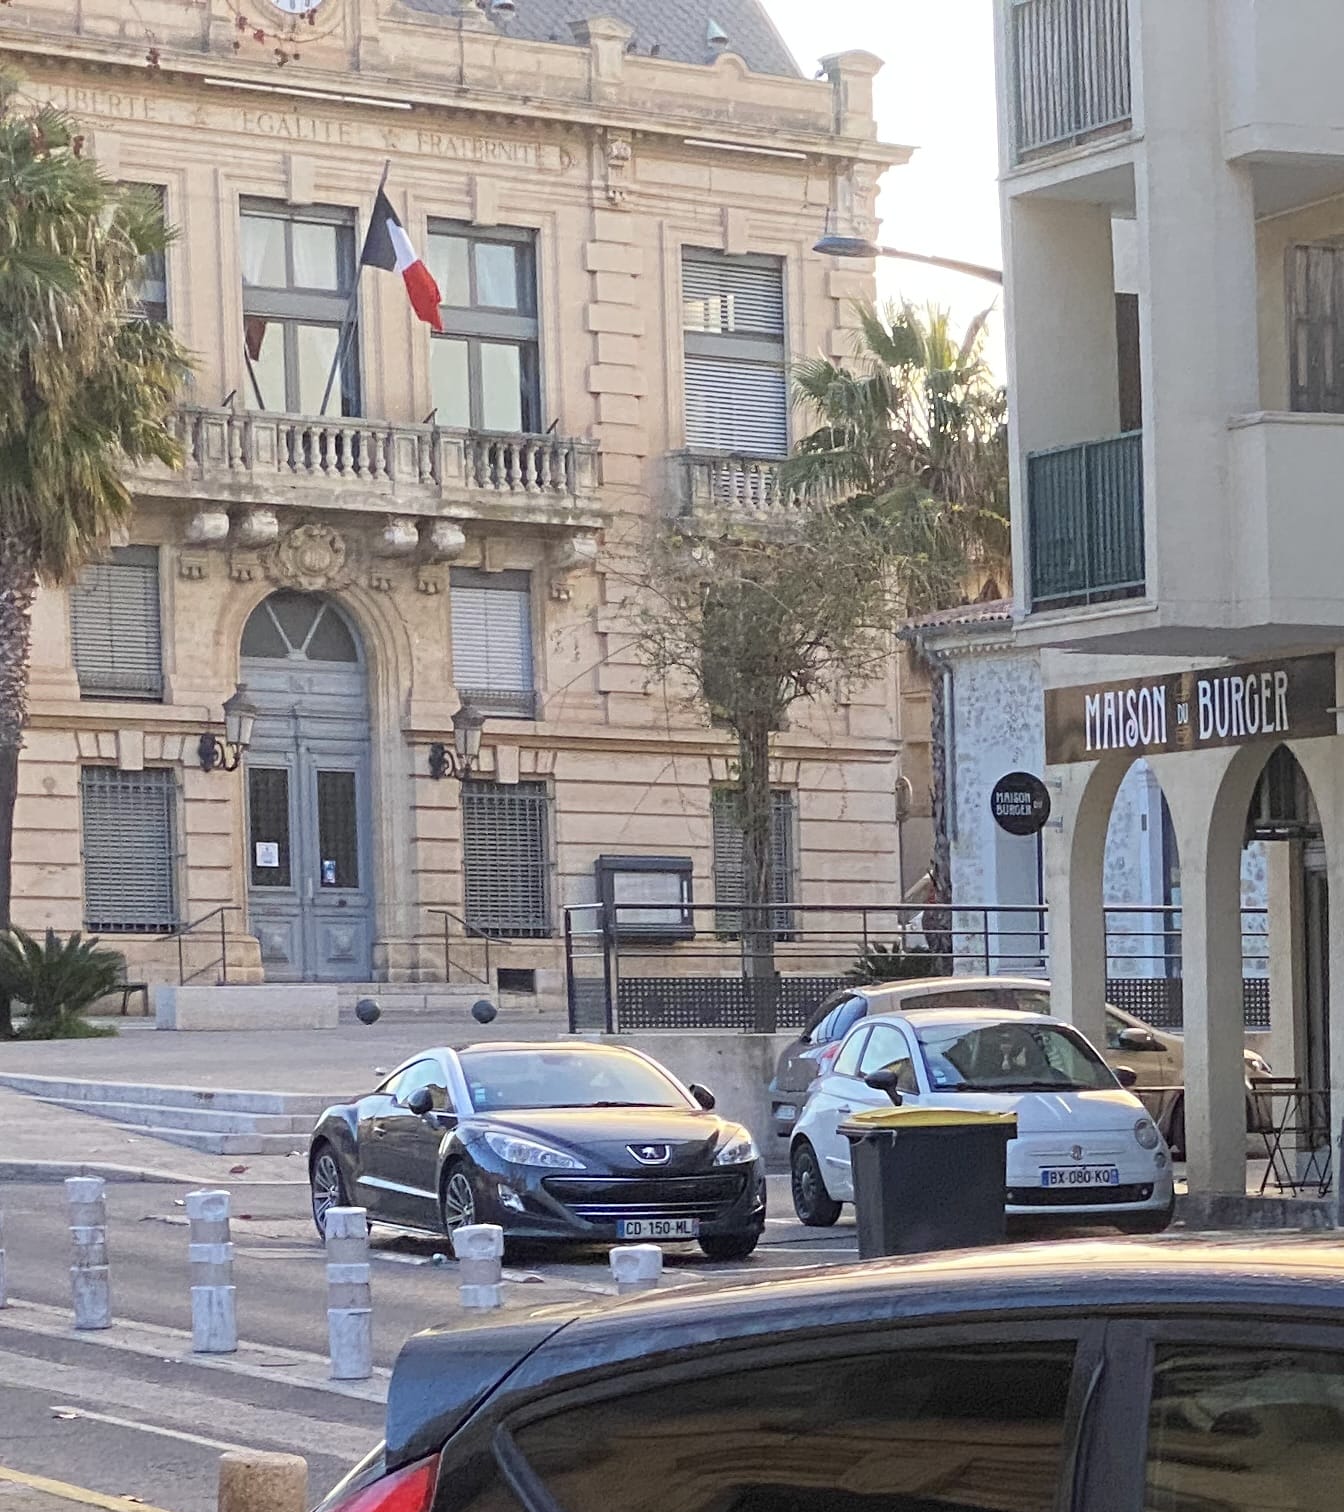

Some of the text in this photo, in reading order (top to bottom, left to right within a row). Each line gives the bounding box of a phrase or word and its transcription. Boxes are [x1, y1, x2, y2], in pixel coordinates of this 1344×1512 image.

[1085, 671, 1289, 751] MAISON DU BURGER
[996, 791, 1031, 803] MAISON
[996, 804, 1032, 816] BURGER
